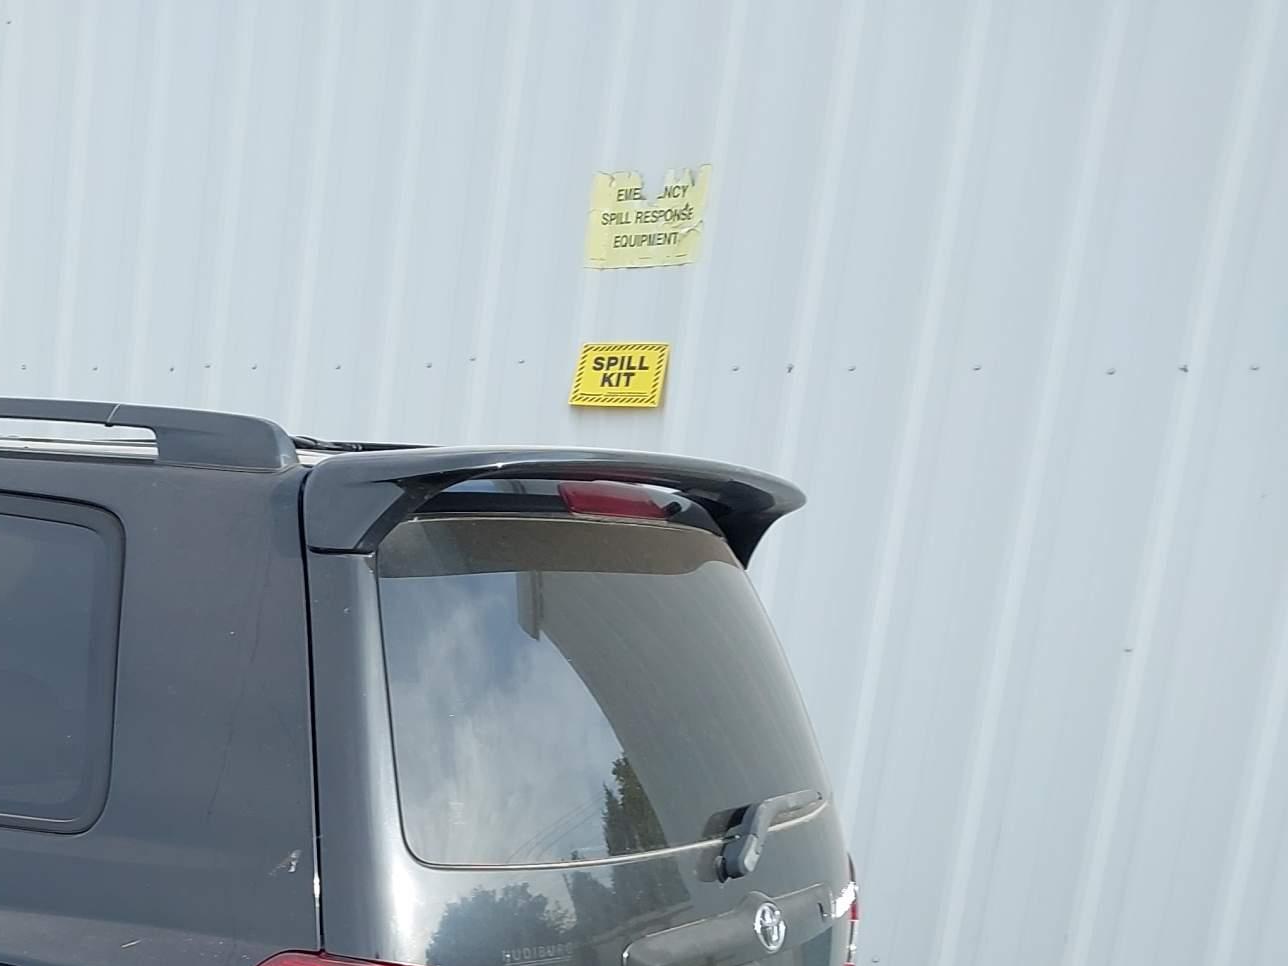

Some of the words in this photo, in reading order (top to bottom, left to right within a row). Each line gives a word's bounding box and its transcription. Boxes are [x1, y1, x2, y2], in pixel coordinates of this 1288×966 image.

[616, 184, 689, 202] EMENCY
[600, 211, 632, 226] SPILL
[634, 205, 695, 224] RESPONSE
[612, 231, 680, 249] EQUIPMENT
[592, 355, 650, 372] SPILL
[599, 372, 636, 388] KIT
